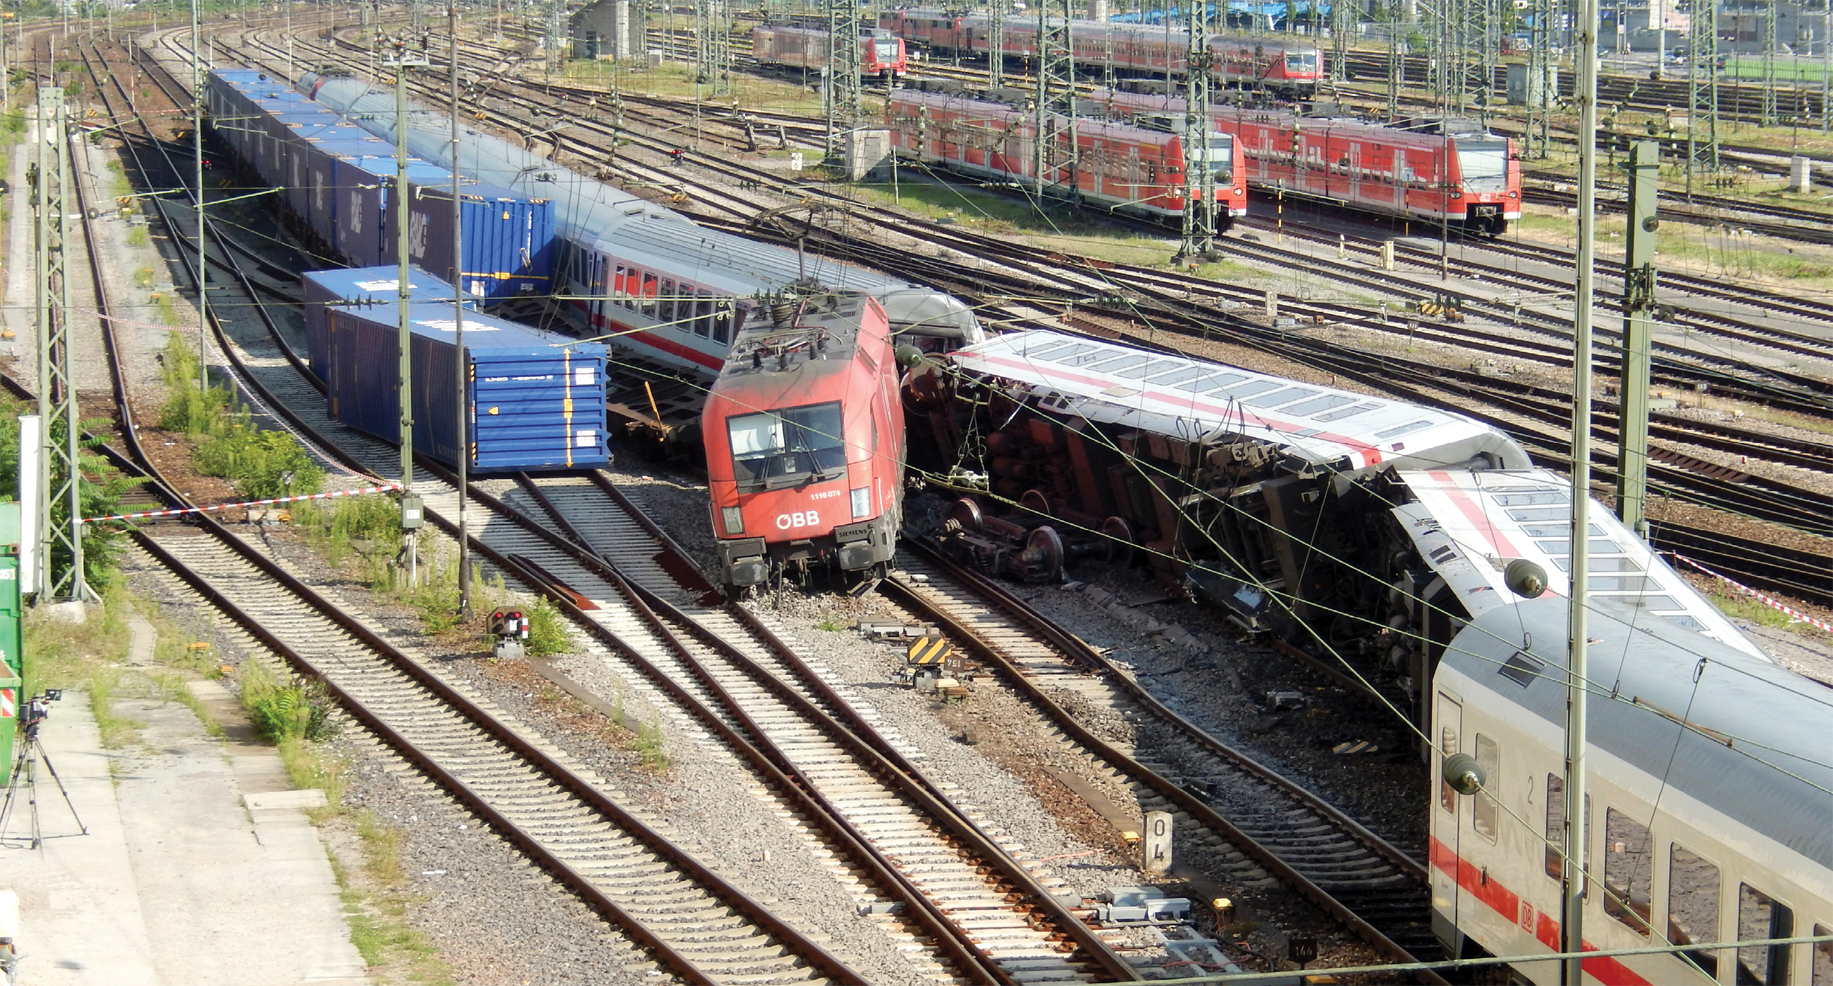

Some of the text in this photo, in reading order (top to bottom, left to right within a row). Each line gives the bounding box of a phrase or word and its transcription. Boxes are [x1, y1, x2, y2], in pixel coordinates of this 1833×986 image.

[828, 489, 841, 498] 074
[838, 528, 868, 538] SIEMENS
[1527, 775, 1534, 805] 2
[1154, 818, 1166, 837] 0
[1153, 843, 1165, 862] 4
[1522, 903, 1533, 930] DB
